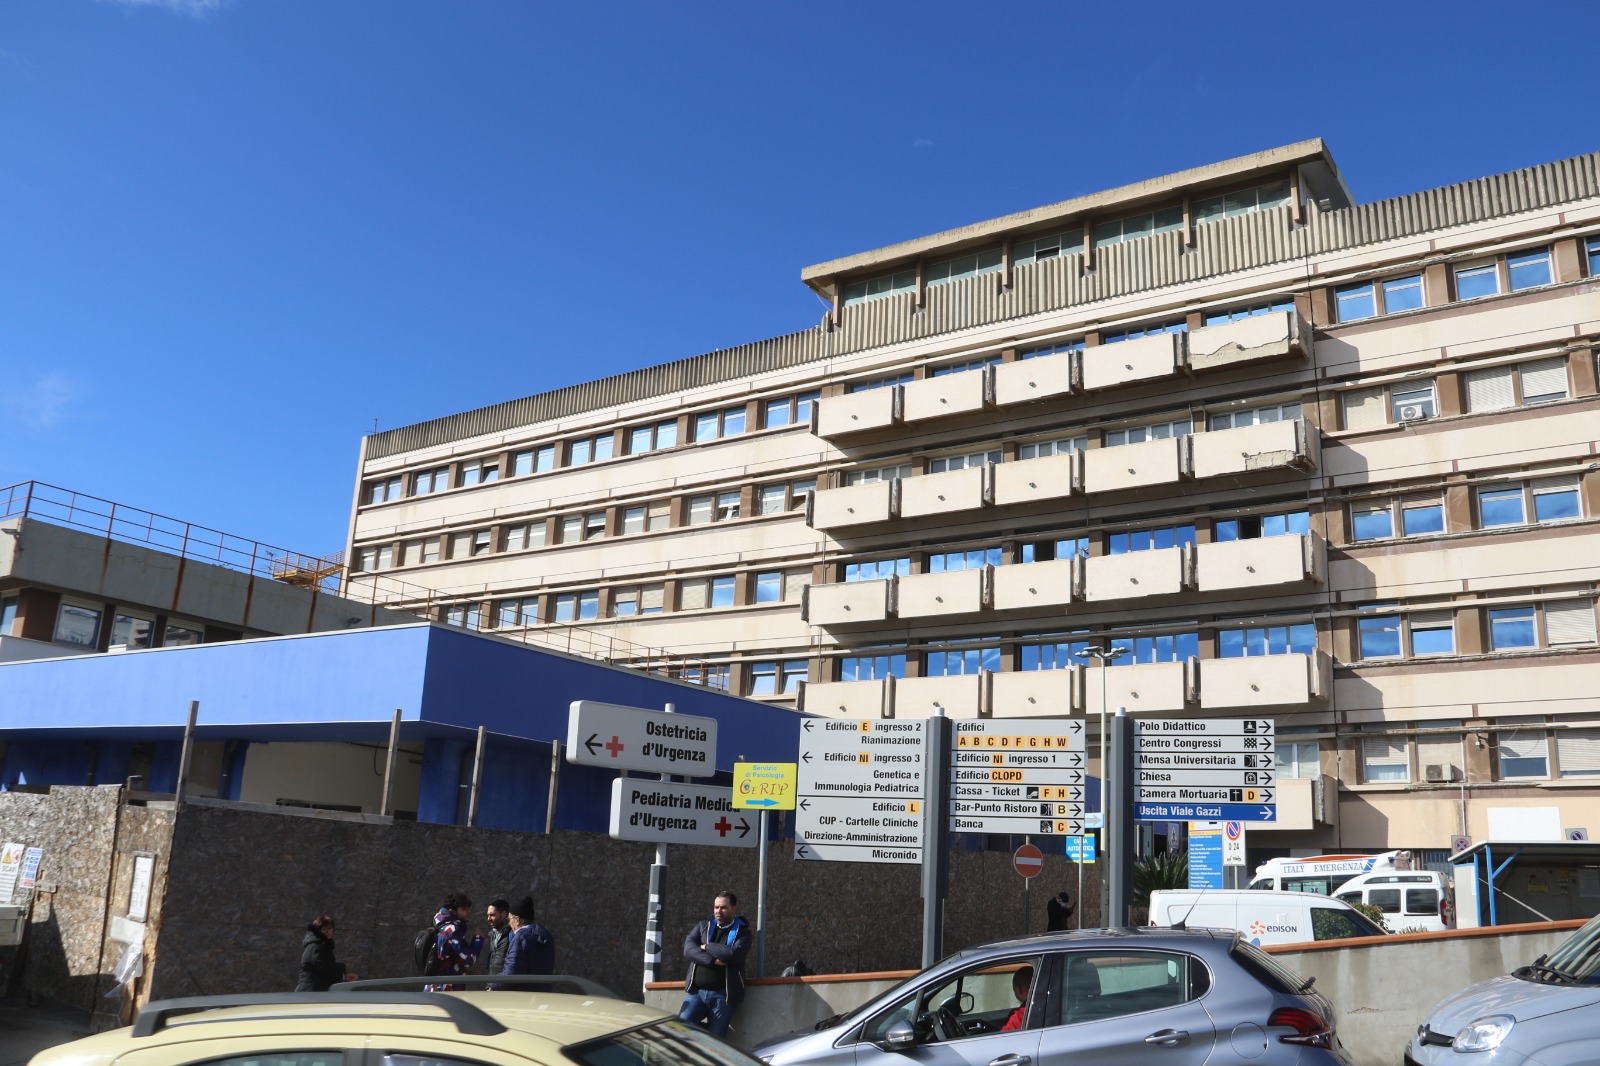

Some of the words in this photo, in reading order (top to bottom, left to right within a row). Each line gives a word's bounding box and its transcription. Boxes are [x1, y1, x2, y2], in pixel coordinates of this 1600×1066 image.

[826, 722, 857, 731] Edificio
[876, 723, 912, 733] ingresso
[957, 723, 984, 731] Edifici
[1140, 722, 1159, 730] Polo
[1163, 722, 1206, 730] Didattico
[646, 721, 706, 742] Ostetricia
[862, 736, 920, 744] Rianimazione
[1030, 738, 1036, 746] G
[1140, 739, 1170, 747] Centro
[1174, 739, 1221, 749] Congressi
[643, 743, 706, 762] d'Urgenza
[825, 753, 856, 761] Edificio
[875, 754, 912, 763] ingresso
[956, 754, 989, 762] Edificio
[1009, 754, 1048, 764] ingresso
[1140, 755, 1170, 764] Mensa
[1174, 756, 1236, 764] Universitaria
[874, 770, 911, 779] Genetica
[956, 771, 989, 779] Edificio
[992, 772, 1022, 780] CLOPD
[1140, 772, 1171, 781] Chiesa
[815, 782, 871, 793] Immunologia
[875, 784, 919, 792] Pediatrica
[955, 786, 982, 795] Cassa
[992, 787, 1020, 796] Ticket
[1140, 789, 1176, 798] Camera
[1180, 790, 1227, 799] Mortuaria
[1248, 791, 1254, 800] D
[632, 790, 691, 809] Pediatria
[695, 797, 740, 812] Medic
[873, 803, 905, 811] Edificio
[955, 803, 1001, 812] Bar-Punto
[1004, 804, 1037, 813] Ristoro
[1058, 805, 1065, 814] B
[1140, 806, 1167, 815] Uscita
[1170, 806, 1193, 816] Viale
[1196, 807, 1221, 816] Gazzi
[630, 812, 696, 831] d'Urgenza
[846, 817, 880, 826] Cartelle
[883, 818, 918, 827] Cliniche
[955, 820, 983, 828] Banca
[1058, 823, 1064, 831] C
[804, 831, 917, 843] Direzione-Amministrazione
[873, 850, 917, 859] Micronido
[1283, 865, 1304, 873] ITALY
[1314, 862, 1364, 872] EMERGENZA
